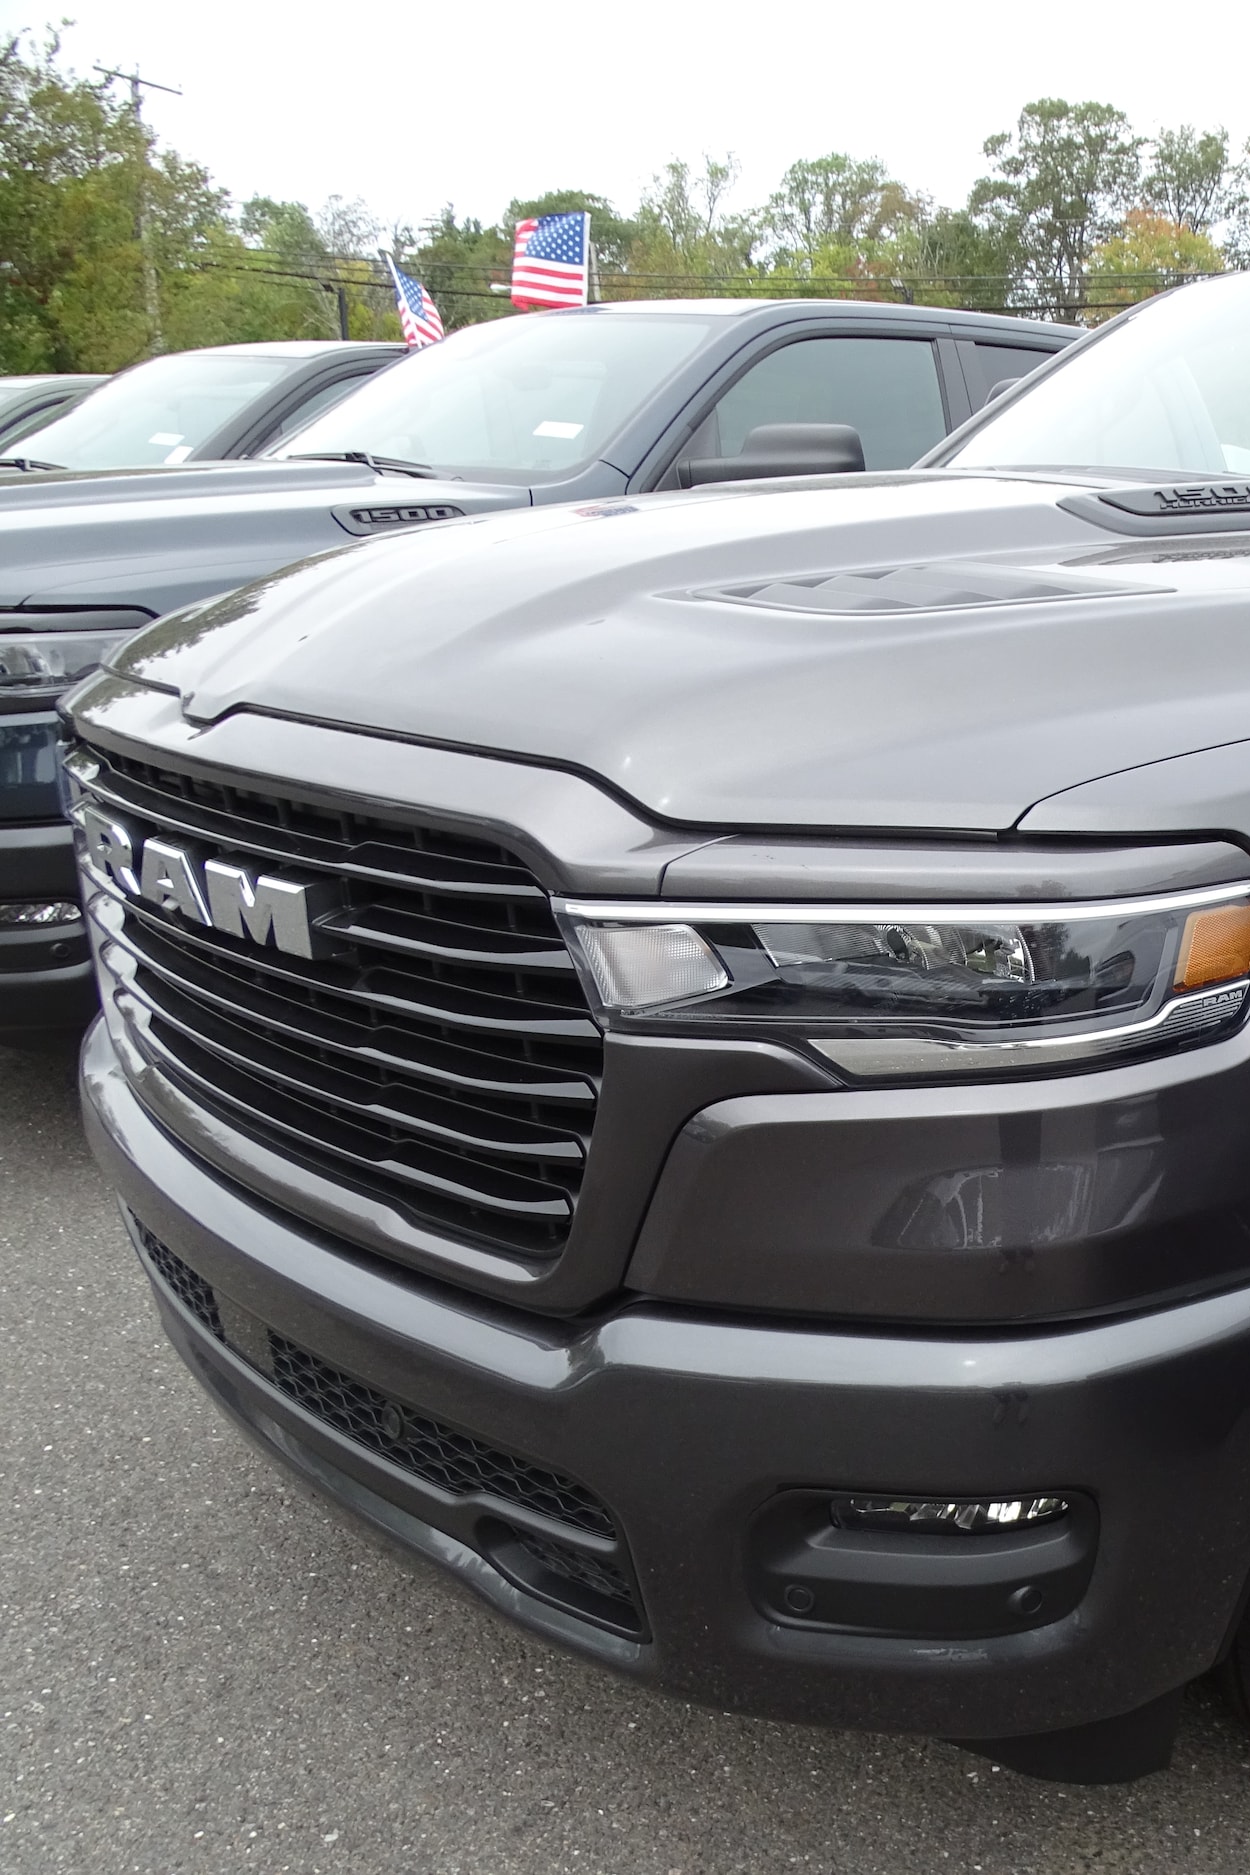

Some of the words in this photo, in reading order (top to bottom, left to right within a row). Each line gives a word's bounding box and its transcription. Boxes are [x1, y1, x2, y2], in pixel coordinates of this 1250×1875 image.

[352, 506, 456, 524] 1500
[78, 804, 314, 961] RAM
[1203, 989, 1243, 1007] RAM
